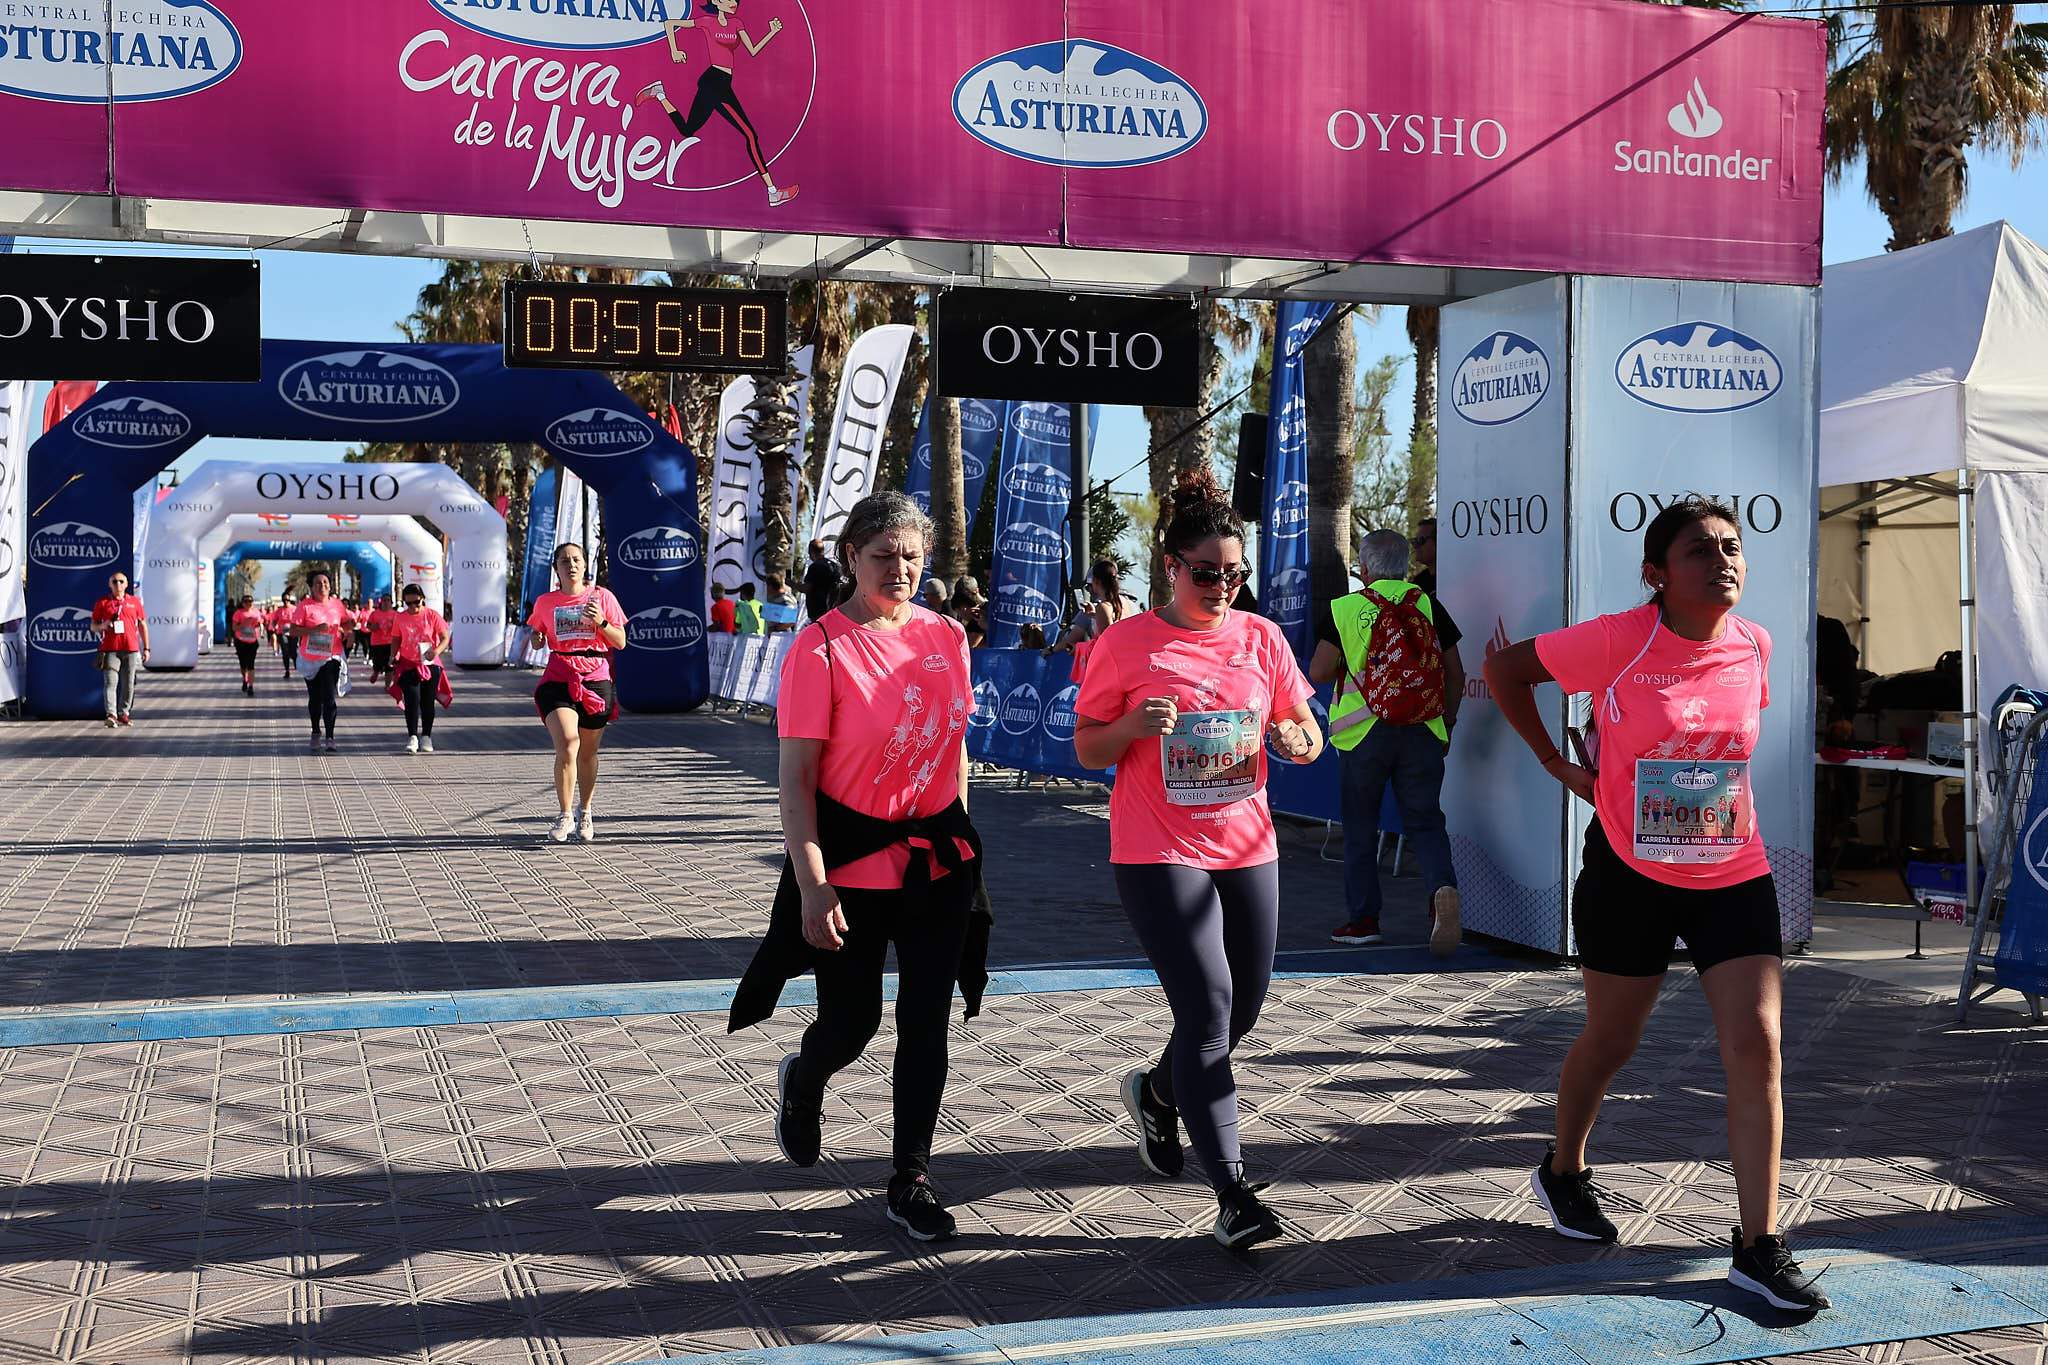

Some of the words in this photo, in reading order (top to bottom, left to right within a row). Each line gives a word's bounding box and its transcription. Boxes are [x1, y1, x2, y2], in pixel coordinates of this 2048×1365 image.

[6, 4, 91, 21] ENTRAL
[446, 0, 668, 22] URIANA
[0, 23, 218, 71] TURIANA
[398, 29, 621, 108] Carrera
[1013, 79, 1092, 96] CENTRAL
[1100, 86, 1181, 102] LECHERA
[973, 79, 1188, 139] ASTURIANA
[1326, 109, 1509, 160] OYSHO
[453, 102, 496, 146] de
[504, 103, 534, 150] la
[527, 104, 701, 208] Mujer
[1613, 140, 1774, 181] Santander
[0, 294, 215, 343] OYSHO
[526, 296, 766, 358] 00:56:48
[982, 325, 1163, 371] OYSHO
[1652, 351, 1706, 363] CENTRAL
[1711, 354, 1766, 365] LECHERA
[1627, 353, 1770, 392] ASTURIANA
[293, 370, 448, 405] ASTURIANA
[1457, 370, 1542, 407] ASTURIANA
[80, 415, 182, 436] ASTURIANA
[961, 411, 991, 429] RIANA
[1014, 411, 1070, 438] ASTURIA
[555, 427, 648, 445] ASTURIANA
[821, 363, 888, 542] YSHO
[256, 472, 400, 501] OYSHO
[168, 503, 213, 513] OYSHO
[439, 504, 482, 513] OYSHO
[1451, 494, 1548, 538] OYSHO
[1609, 492, 1782, 533] OYO
[33, 539, 114, 558] ASTURIANA
[624, 544, 695, 561] ASTURIANA
[148, 560, 191, 569] OYSHO
[461, 561, 501, 569] OYSHO
[460, 615, 500, 625] OYSHO
[998, 601, 1052, 620] TURIANA
[147, 616, 191, 625] OYSHO
[32, 624, 105, 642] ASTURIAN
[628, 623, 699, 640] ASTURIANA
[1633, 672, 1683, 685] OYSHO
[1197, 752, 1233, 768] 016
[1174, 792, 1207, 800] OYSHO
[1675, 806, 1717, 823] 016
[1647, 848, 1685, 857] OYSHO
[1930, 903, 1954, 914] rrera
